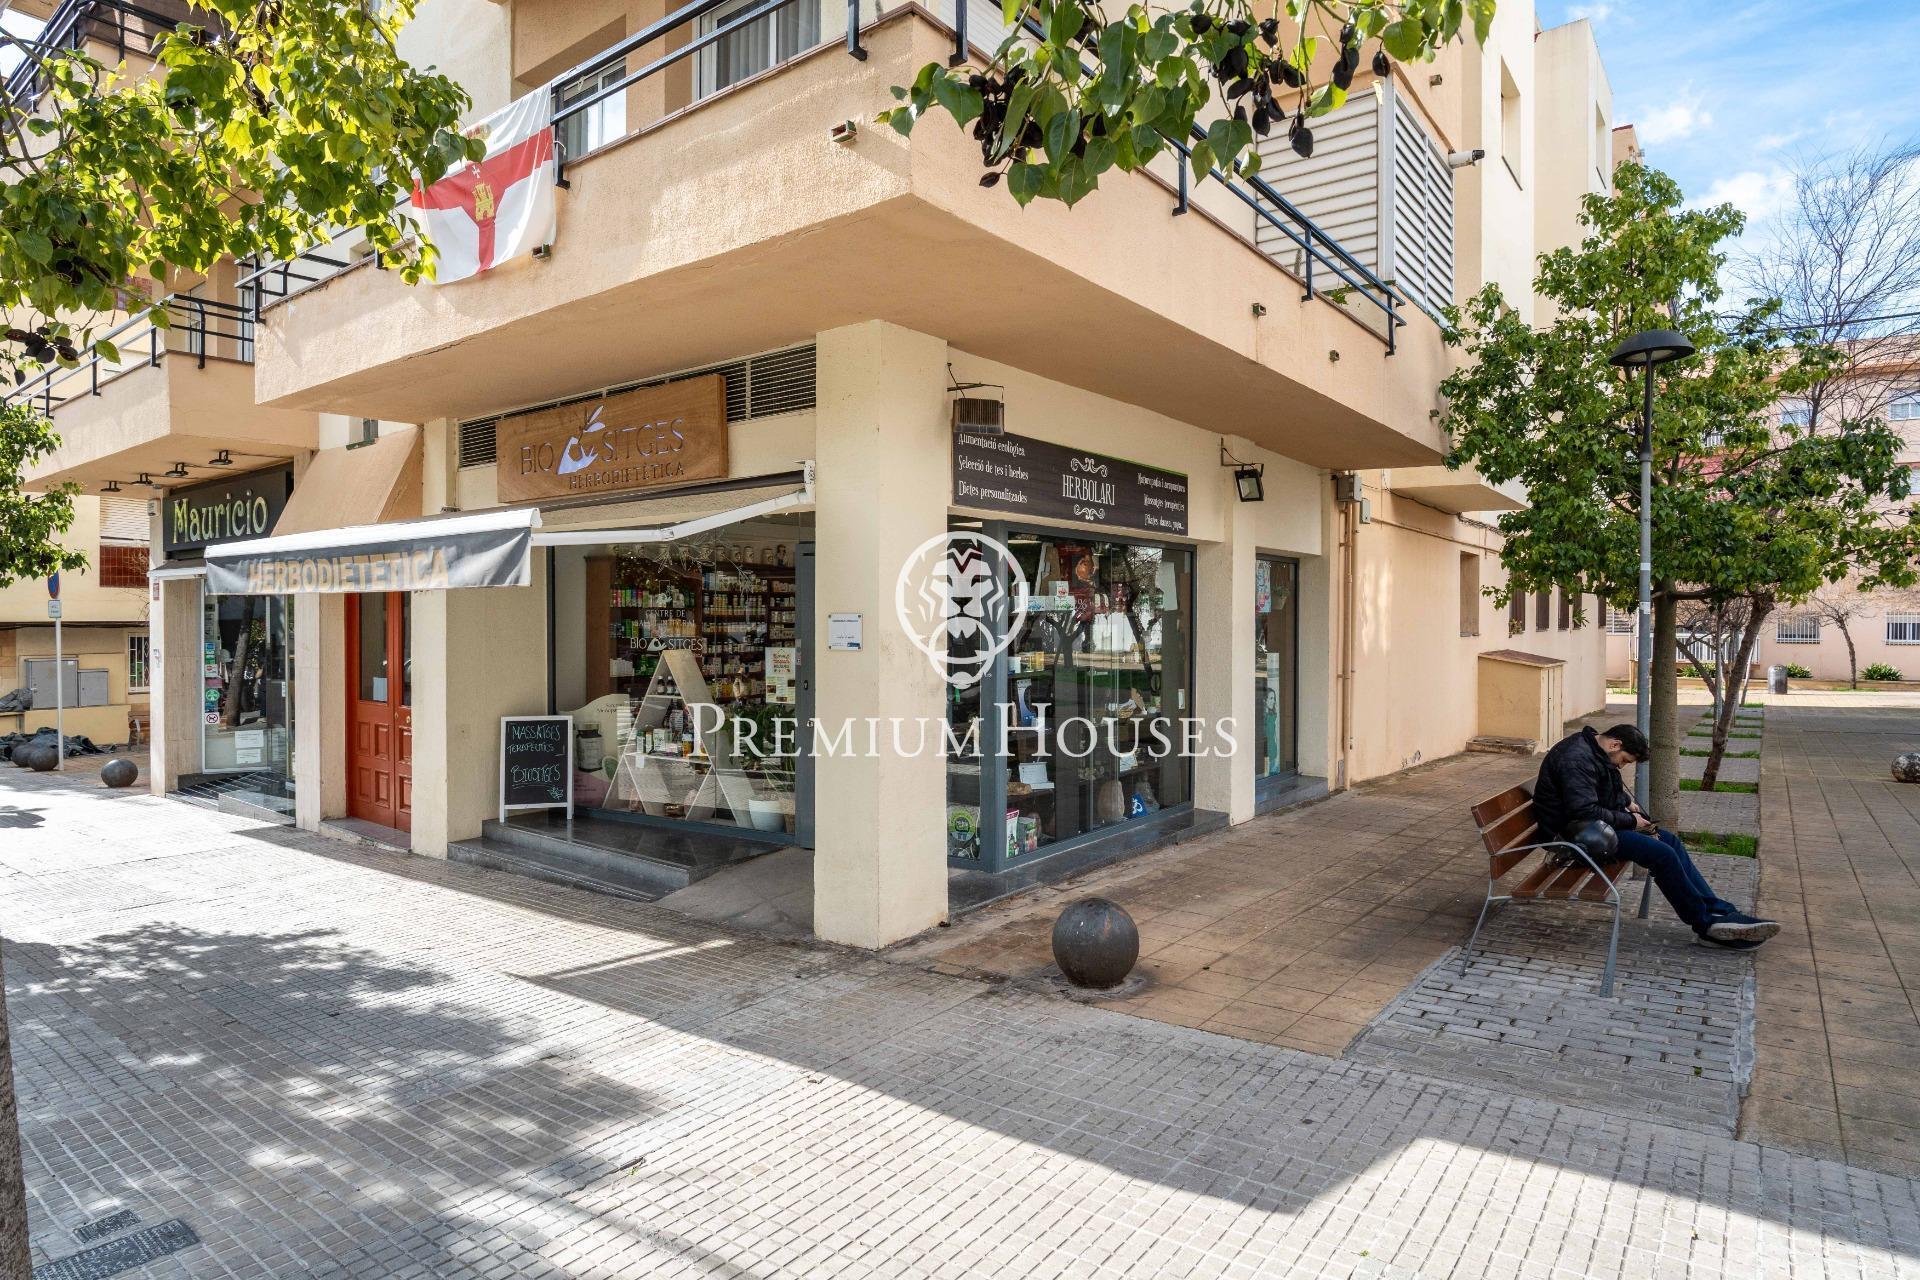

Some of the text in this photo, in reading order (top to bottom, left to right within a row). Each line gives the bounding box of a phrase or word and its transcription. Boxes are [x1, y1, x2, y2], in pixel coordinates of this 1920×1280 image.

[520, 418, 685, 475] BIO SITGES
[958, 454, 984, 472] Selecció
[985, 460, 993, 474] de
[994, 465, 1004, 476] tes
[1008, 465, 1029, 480] herbes
[958, 480, 1028, 504] Dietes personalitzades
[1062, 474, 1116, 506] HERBOLARI
[172, 490, 269, 544] Mauricio
[646, 609, 686, 618] CENTRE DE
[630, 637, 703, 651] BIO SITGES
